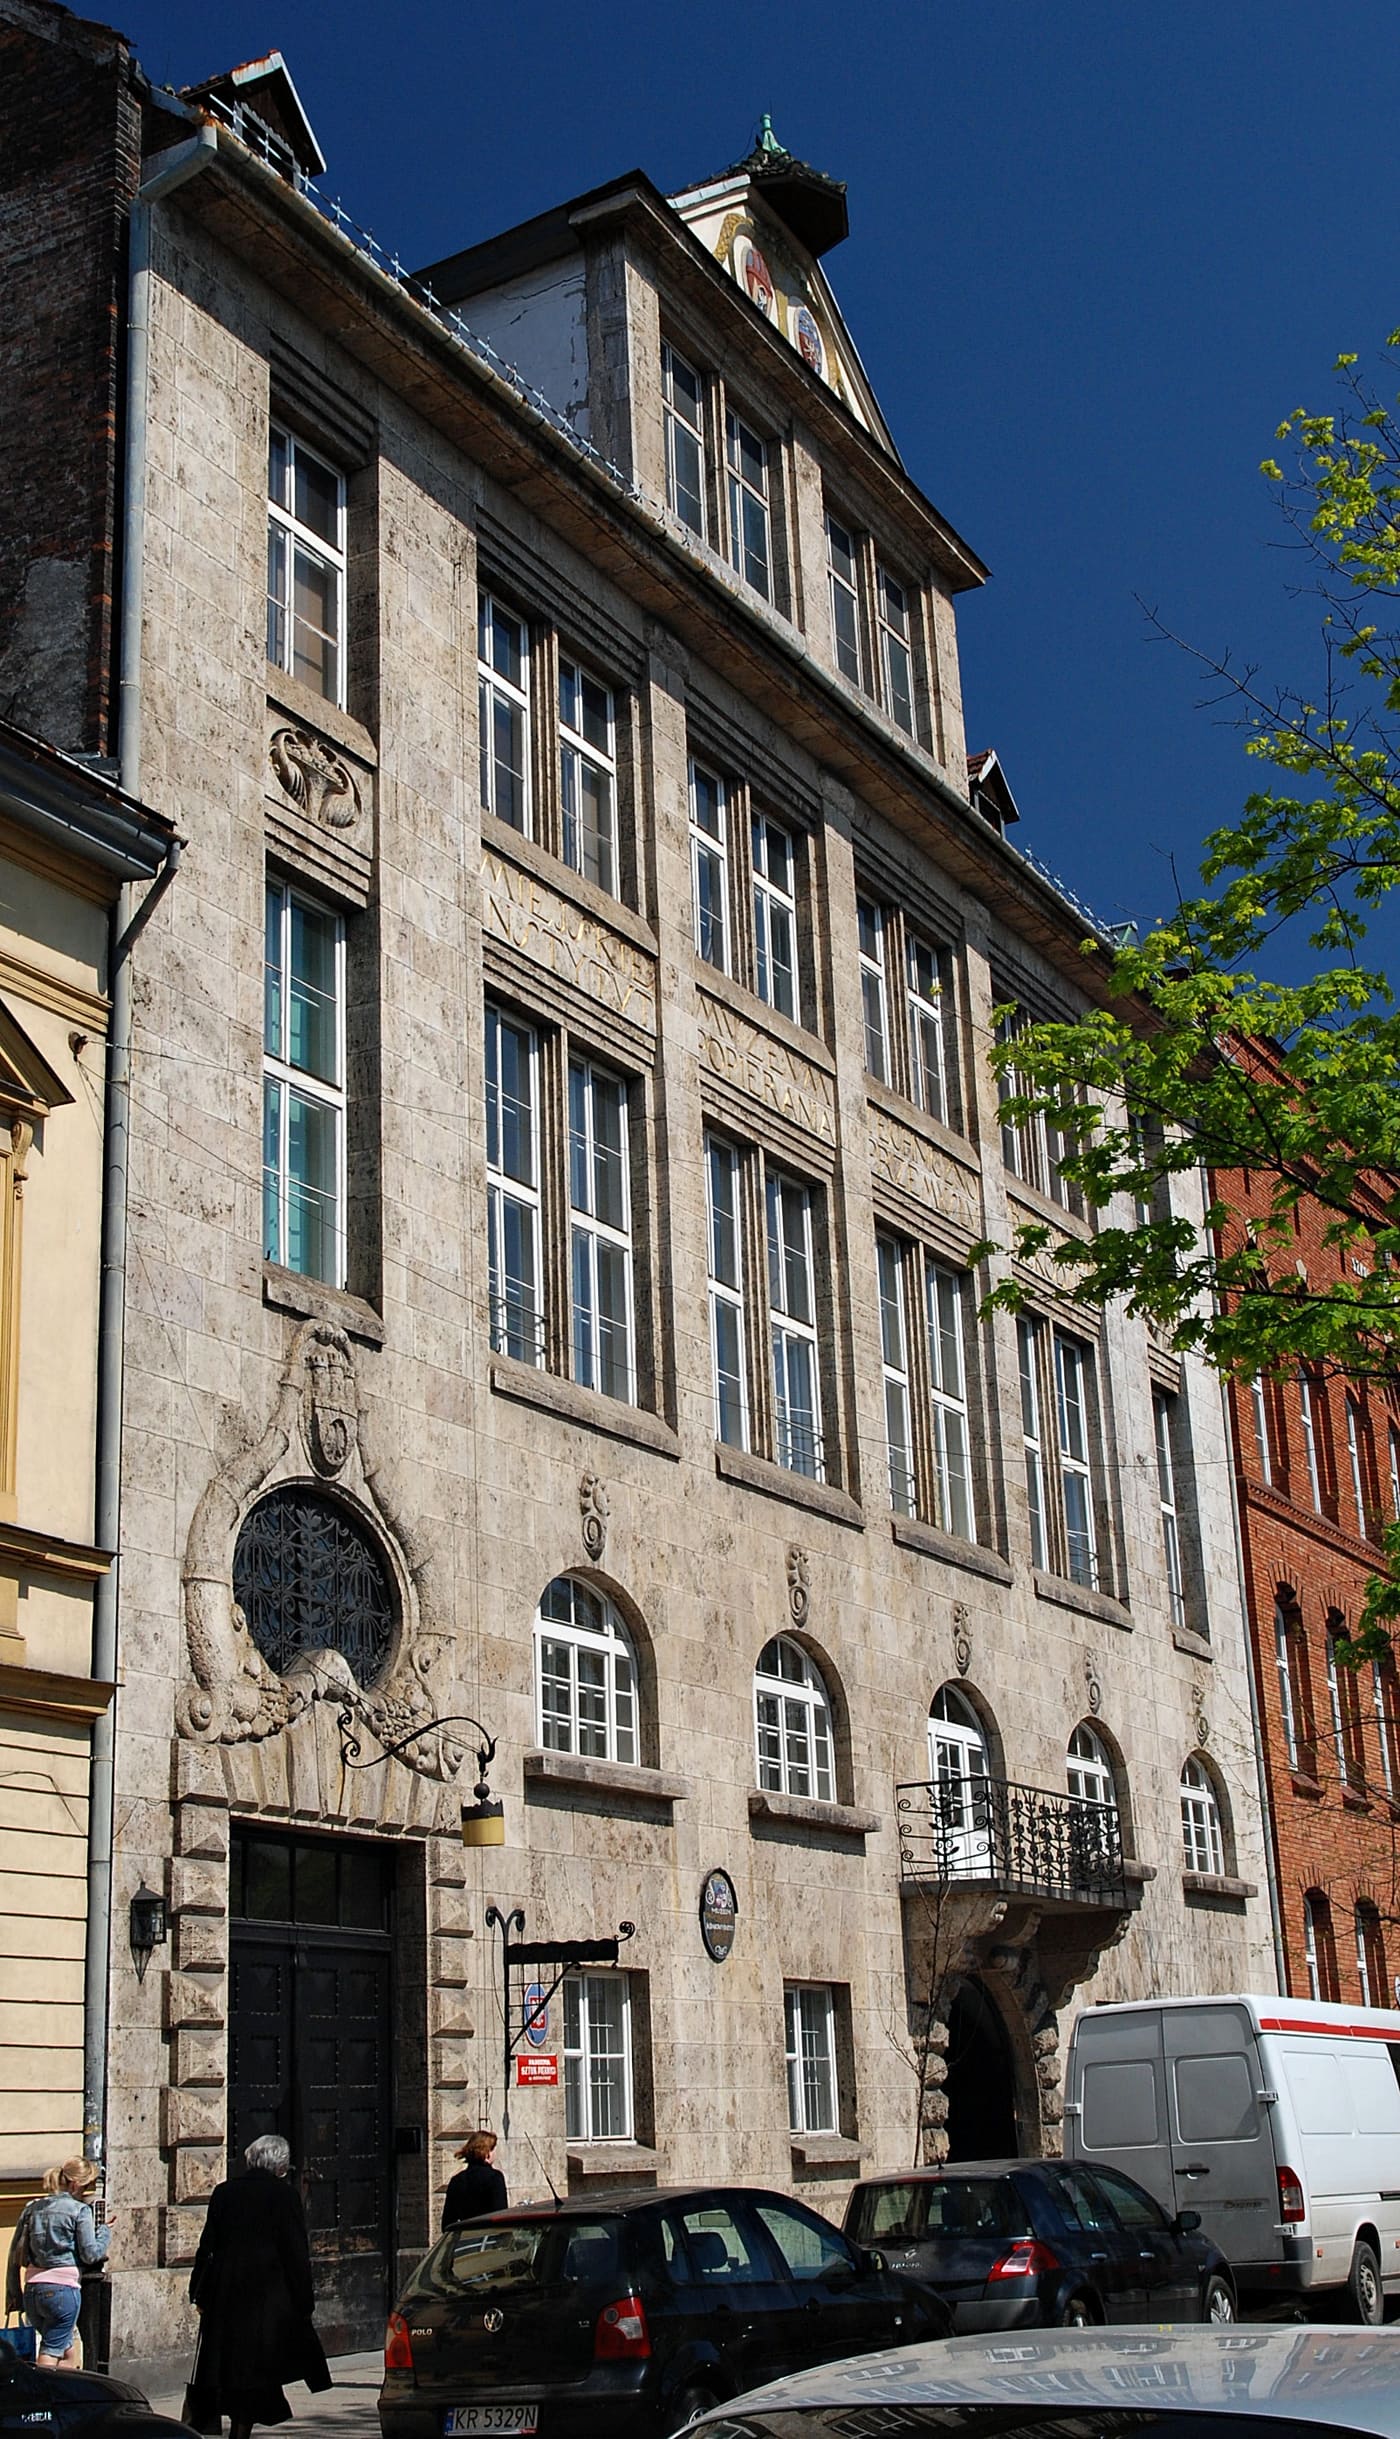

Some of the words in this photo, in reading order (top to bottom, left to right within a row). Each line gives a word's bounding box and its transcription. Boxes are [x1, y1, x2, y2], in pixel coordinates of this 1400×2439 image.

[480, 853, 656, 991] MIEJSKIE
[411, 2328, 433, 2336] POLO
[455, 2409, 479, 2429] KR
[484, 2407, 537, 2427] 5329N
